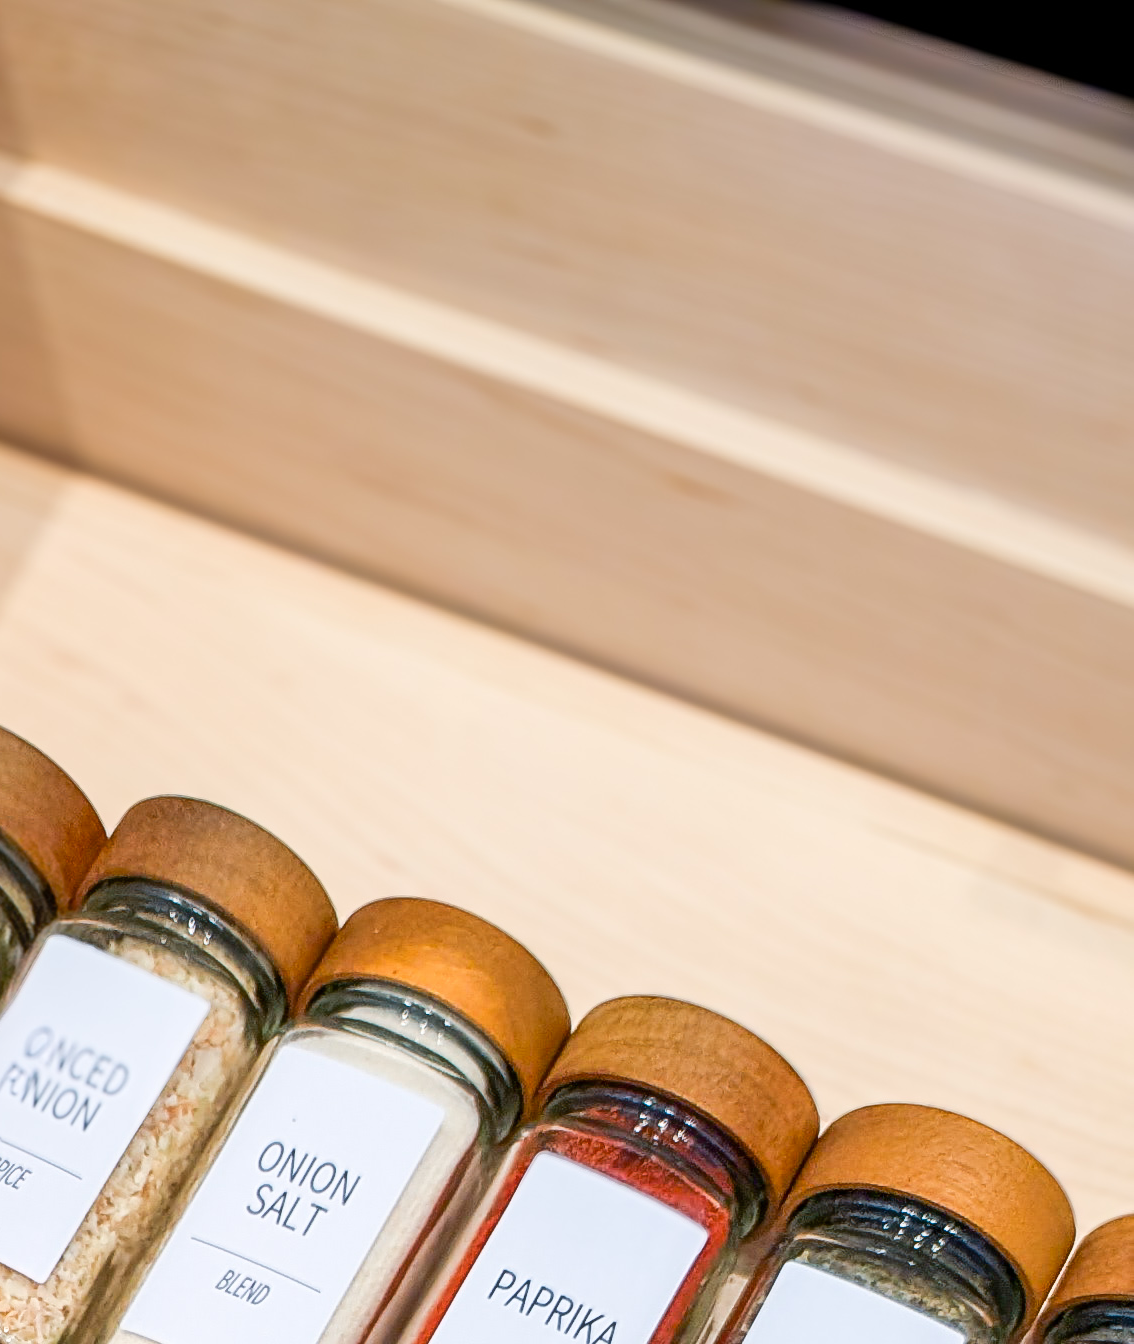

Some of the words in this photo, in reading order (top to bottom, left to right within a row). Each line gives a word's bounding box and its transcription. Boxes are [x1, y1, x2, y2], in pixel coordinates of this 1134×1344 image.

[257, 1141, 360, 1205] ONION
[247, 1185, 327, 1238] SALT
[215, 1270, 271, 1305] BLEND
